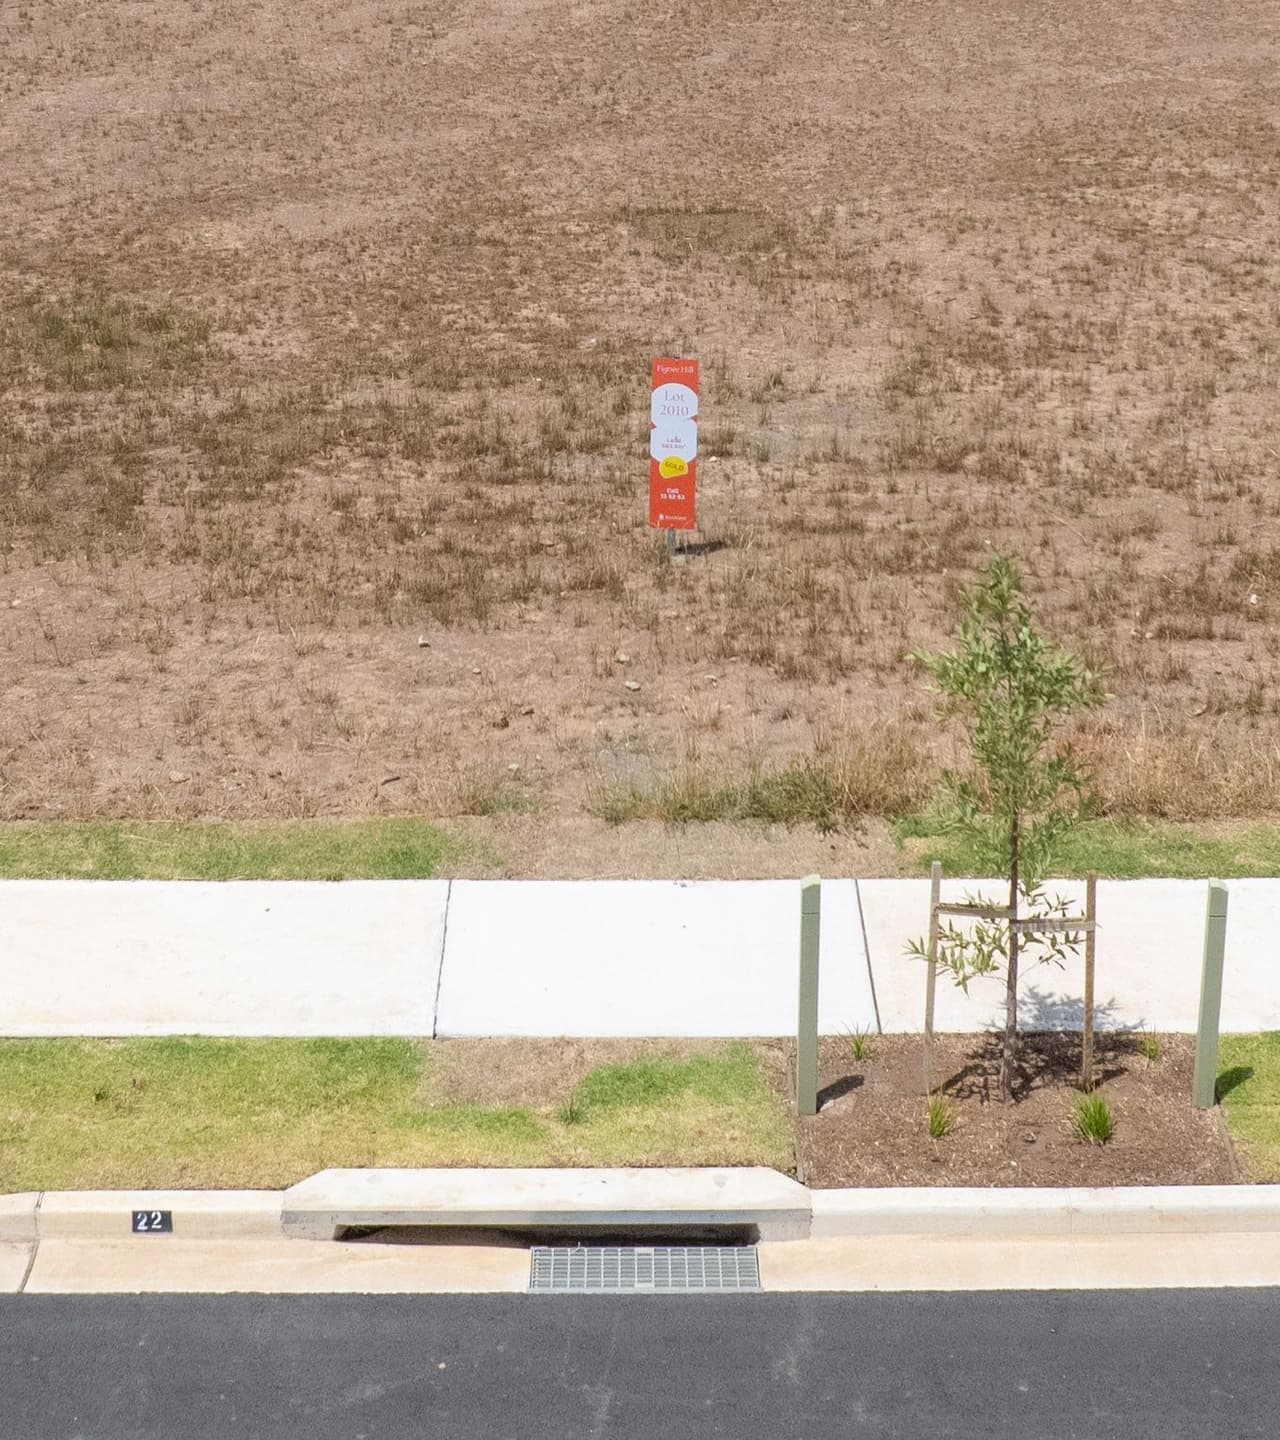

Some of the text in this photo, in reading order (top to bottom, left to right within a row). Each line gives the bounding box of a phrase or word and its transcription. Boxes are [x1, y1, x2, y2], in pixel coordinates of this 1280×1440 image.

[664, 389, 685, 401] Lot
[659, 404, 689, 417] 2010
[137, 1211, 162, 1231] 22
